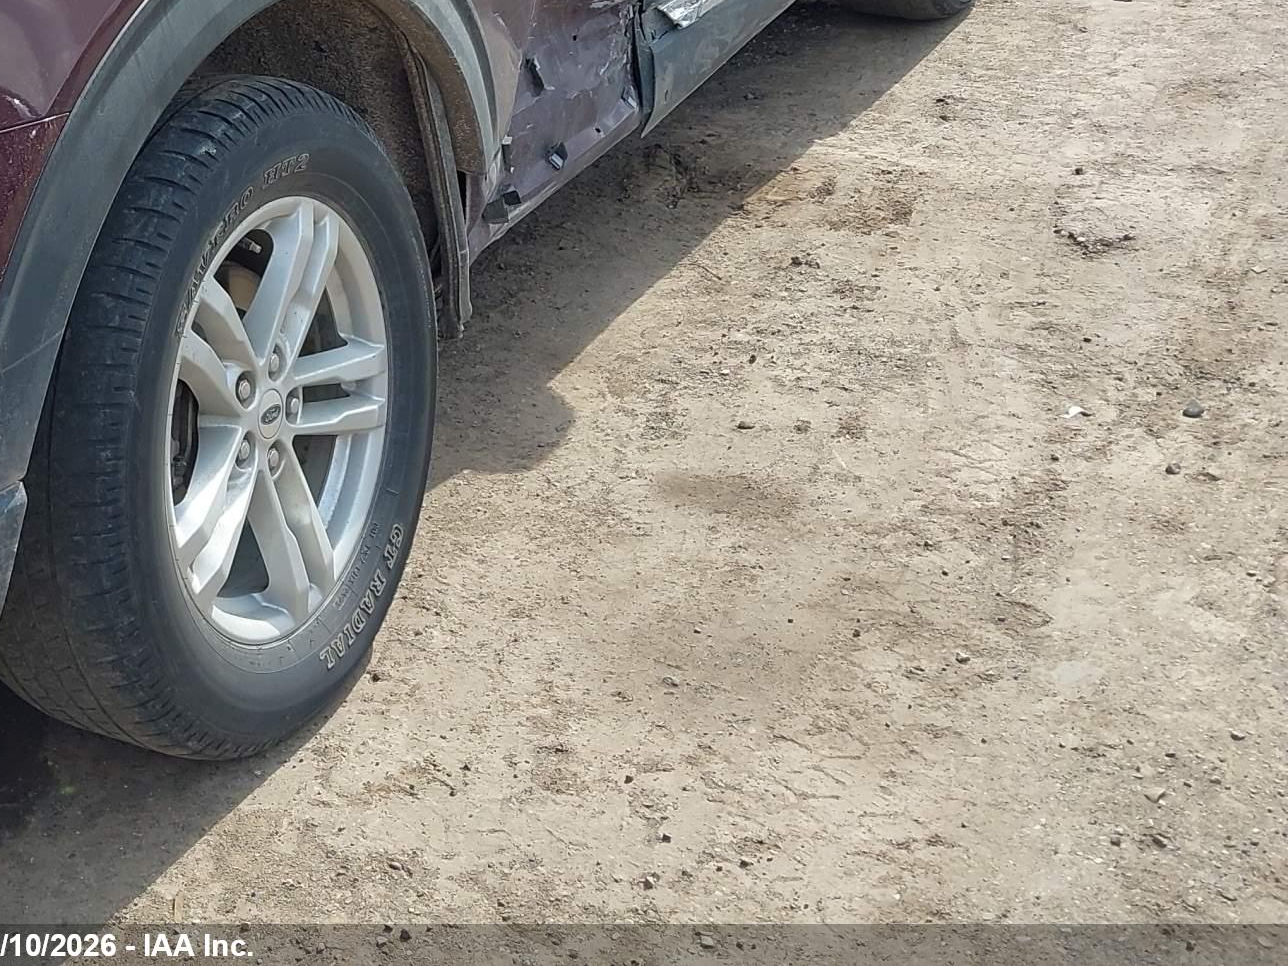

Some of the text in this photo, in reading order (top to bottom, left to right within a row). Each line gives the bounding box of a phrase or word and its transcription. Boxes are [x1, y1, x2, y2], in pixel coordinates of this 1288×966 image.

[263, 153, 311, 186] HT2
[383, 523, 405, 570] GT
[320, 568, 387, 670] RADIAL
